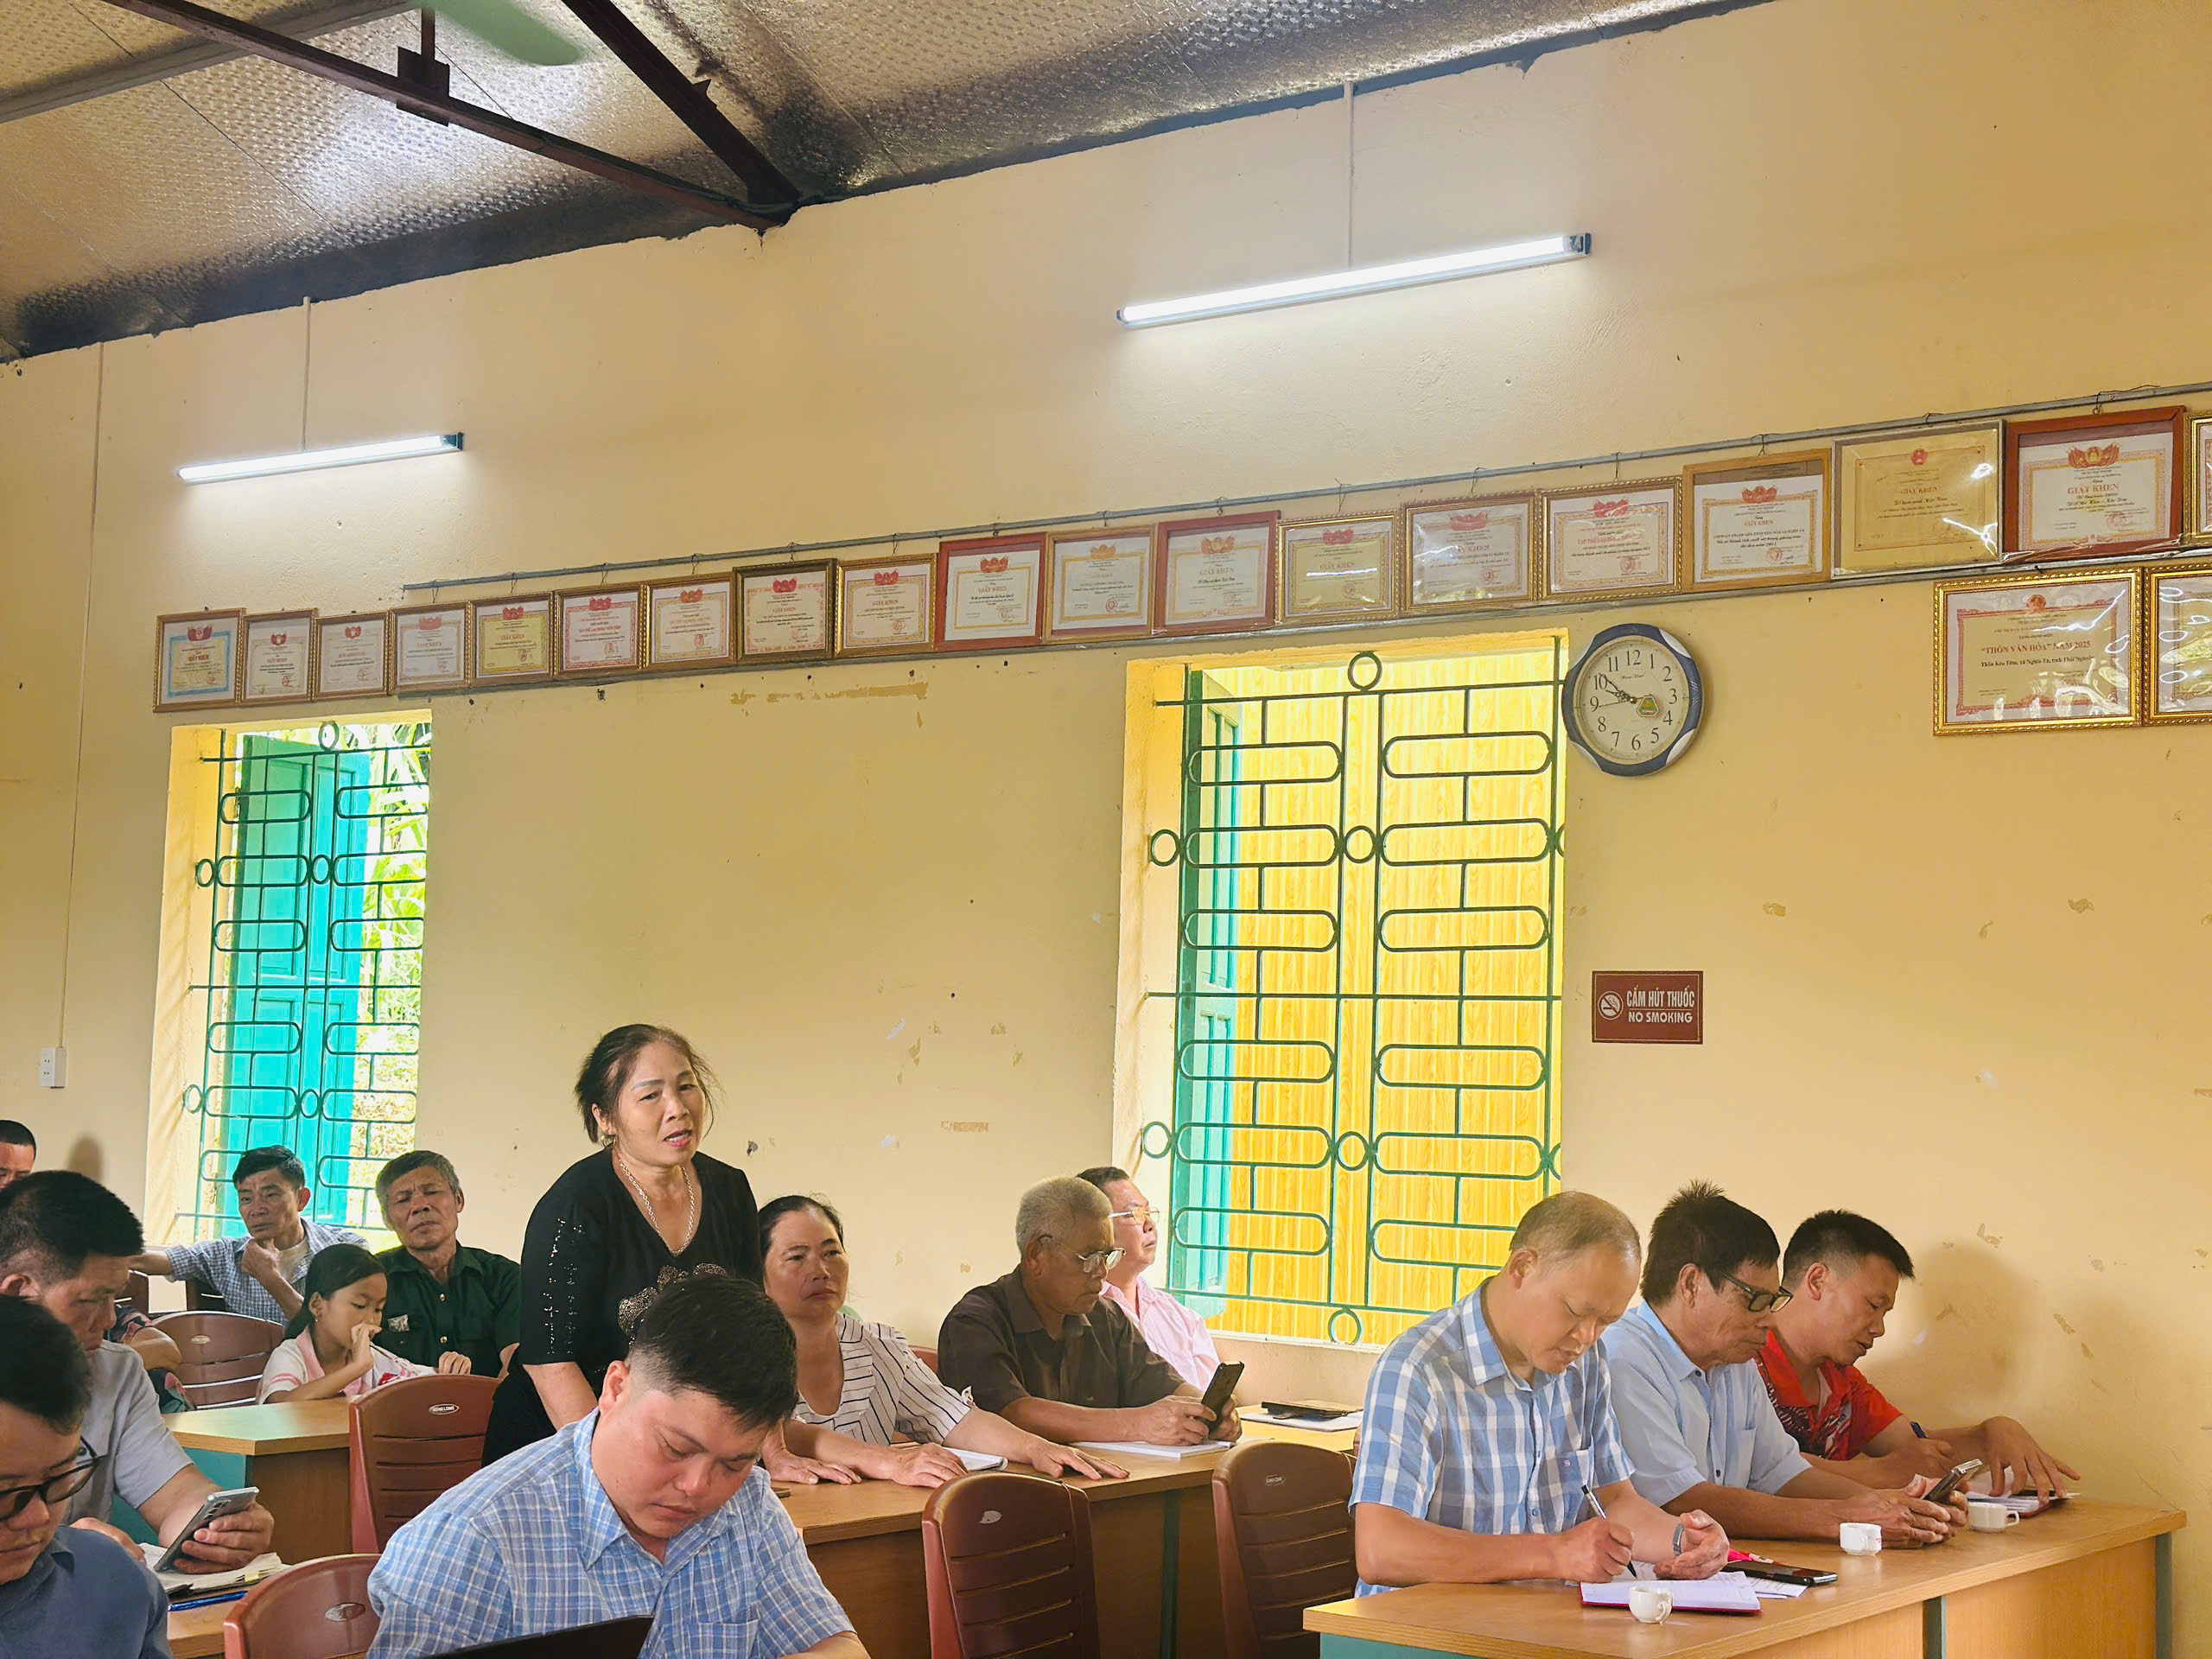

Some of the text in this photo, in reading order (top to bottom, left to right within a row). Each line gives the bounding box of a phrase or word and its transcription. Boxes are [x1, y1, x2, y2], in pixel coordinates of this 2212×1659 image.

[1608, 656, 1618, 672] 11
[1625, 649, 1642, 666] 12
[1649, 653, 1655, 669] 1
[1593, 673, 1608, 690] 10
[1662, 665, 1672, 682] 2
[1590, 696, 1599, 712] 9
[1669, 688, 1677, 704] 3
[1598, 715, 1606, 732] 8
[1662, 710, 1673, 726] 4
[1611, 731, 1620, 747] 7
[1631, 734, 1641, 750] 6
[1650, 728, 1660, 743] 5
[1626, 985, 1695, 1007] CẤM HÚT THUỐC
[1628, 1011, 1694, 1023] NO SMOKING
